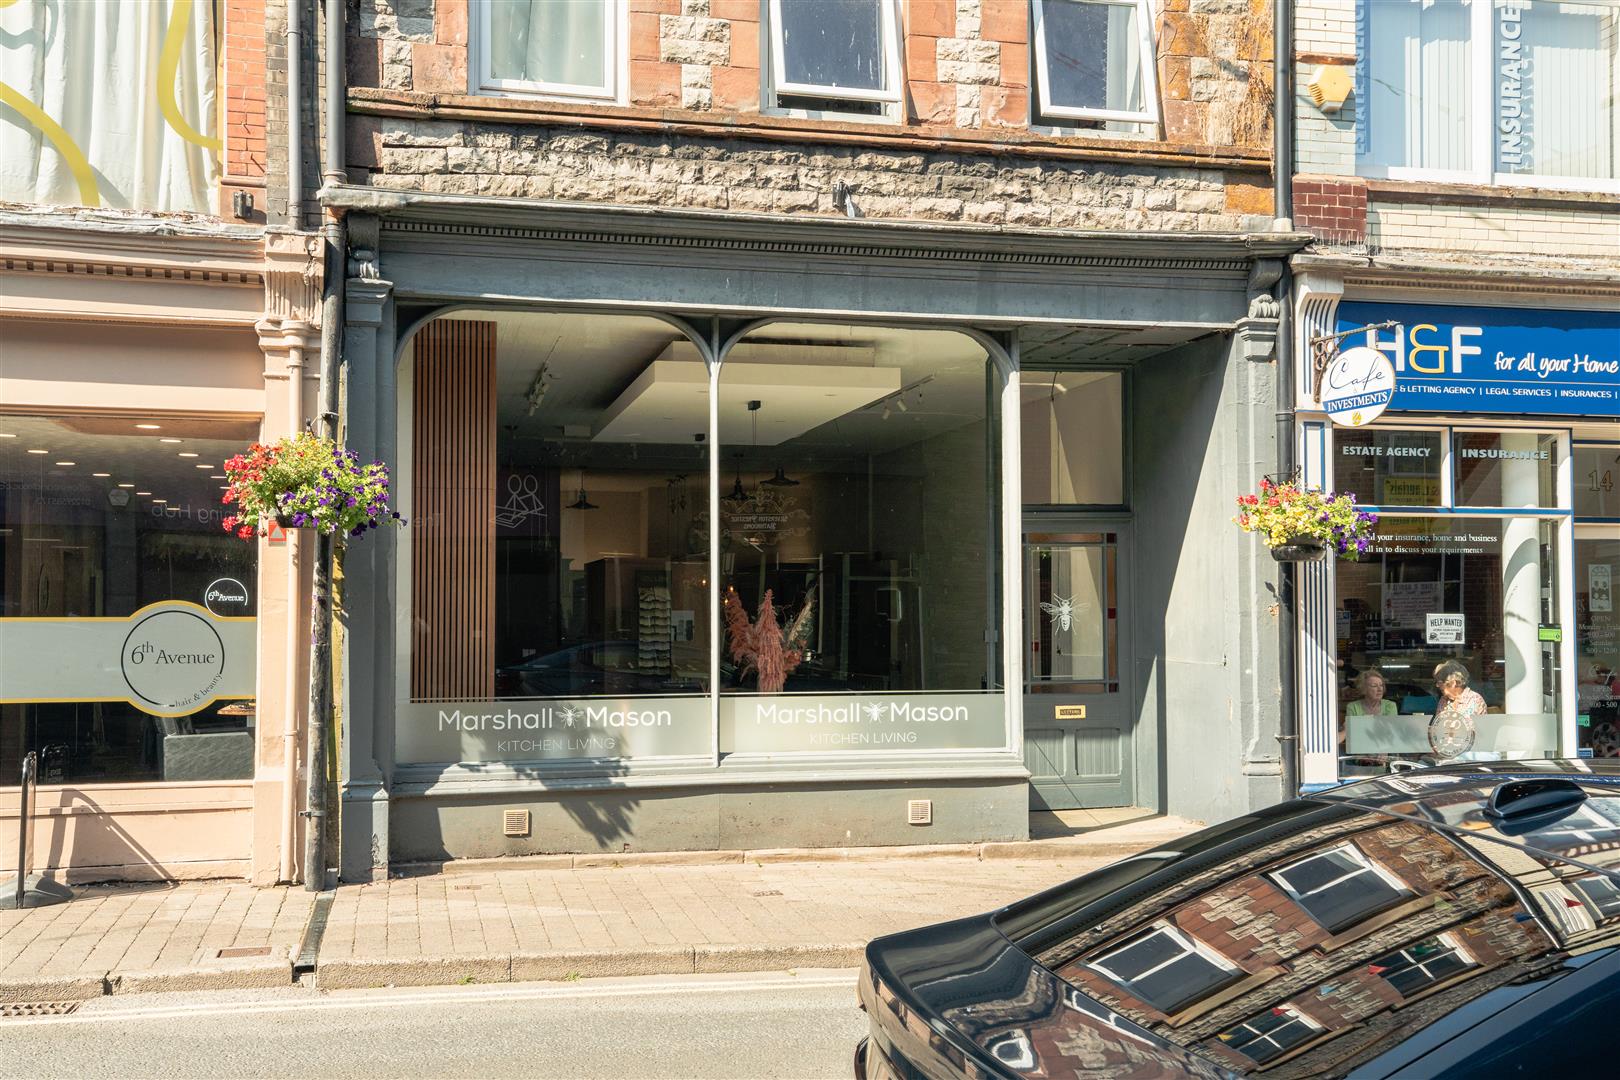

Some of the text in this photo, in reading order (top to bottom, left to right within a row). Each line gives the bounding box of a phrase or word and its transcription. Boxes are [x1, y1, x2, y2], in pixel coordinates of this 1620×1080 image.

[1500, 7, 1522, 165] INSURANCE
[1366, 323, 1482, 374] H&F
[1494, 351, 1619, 378] for all your Home
[1327, 391, 1389, 411] INVESTMENTS
[1407, 385, 1441, 394] LETTING
[1443, 386, 1476, 395] AGENCY
[1485, 387, 1511, 396] LEGAL
[1512, 388, 1552, 397] SERVICES
[1560, 390, 1612, 399] INSURANCES
[1342, 446, 1431, 458] ESTATE AGENCY
[1462, 449, 1549, 460] INSURANCE
[1588, 470, 1613, 492] 14
[1377, 534, 1393, 543] your
[1395, 533, 1431, 543] insurance,
[1432, 532, 1452, 542] home
[1454, 533, 1467, 542] and
[1468, 533, 1498, 542] business
[1375, 545, 1384, 553] in
[1394, 545, 1419, 553] discuss
[1421, 546, 1438, 554] your
[1439, 546, 1484, 555] requirements
[208, 589, 245, 602] 6th Avenue
[1430, 618, 1462, 627] HELP WANTED
[131, 641, 215, 665] 6th Avenue
[175, 673, 222, 708] hair & beauty
[438, 706, 672, 731] Marshall Mason
[757, 702, 969, 724] Marshall Mason
[497, 737, 616, 753] KITCHEN LIVING
[810, 731, 918, 745] KITCHEN LIVING
